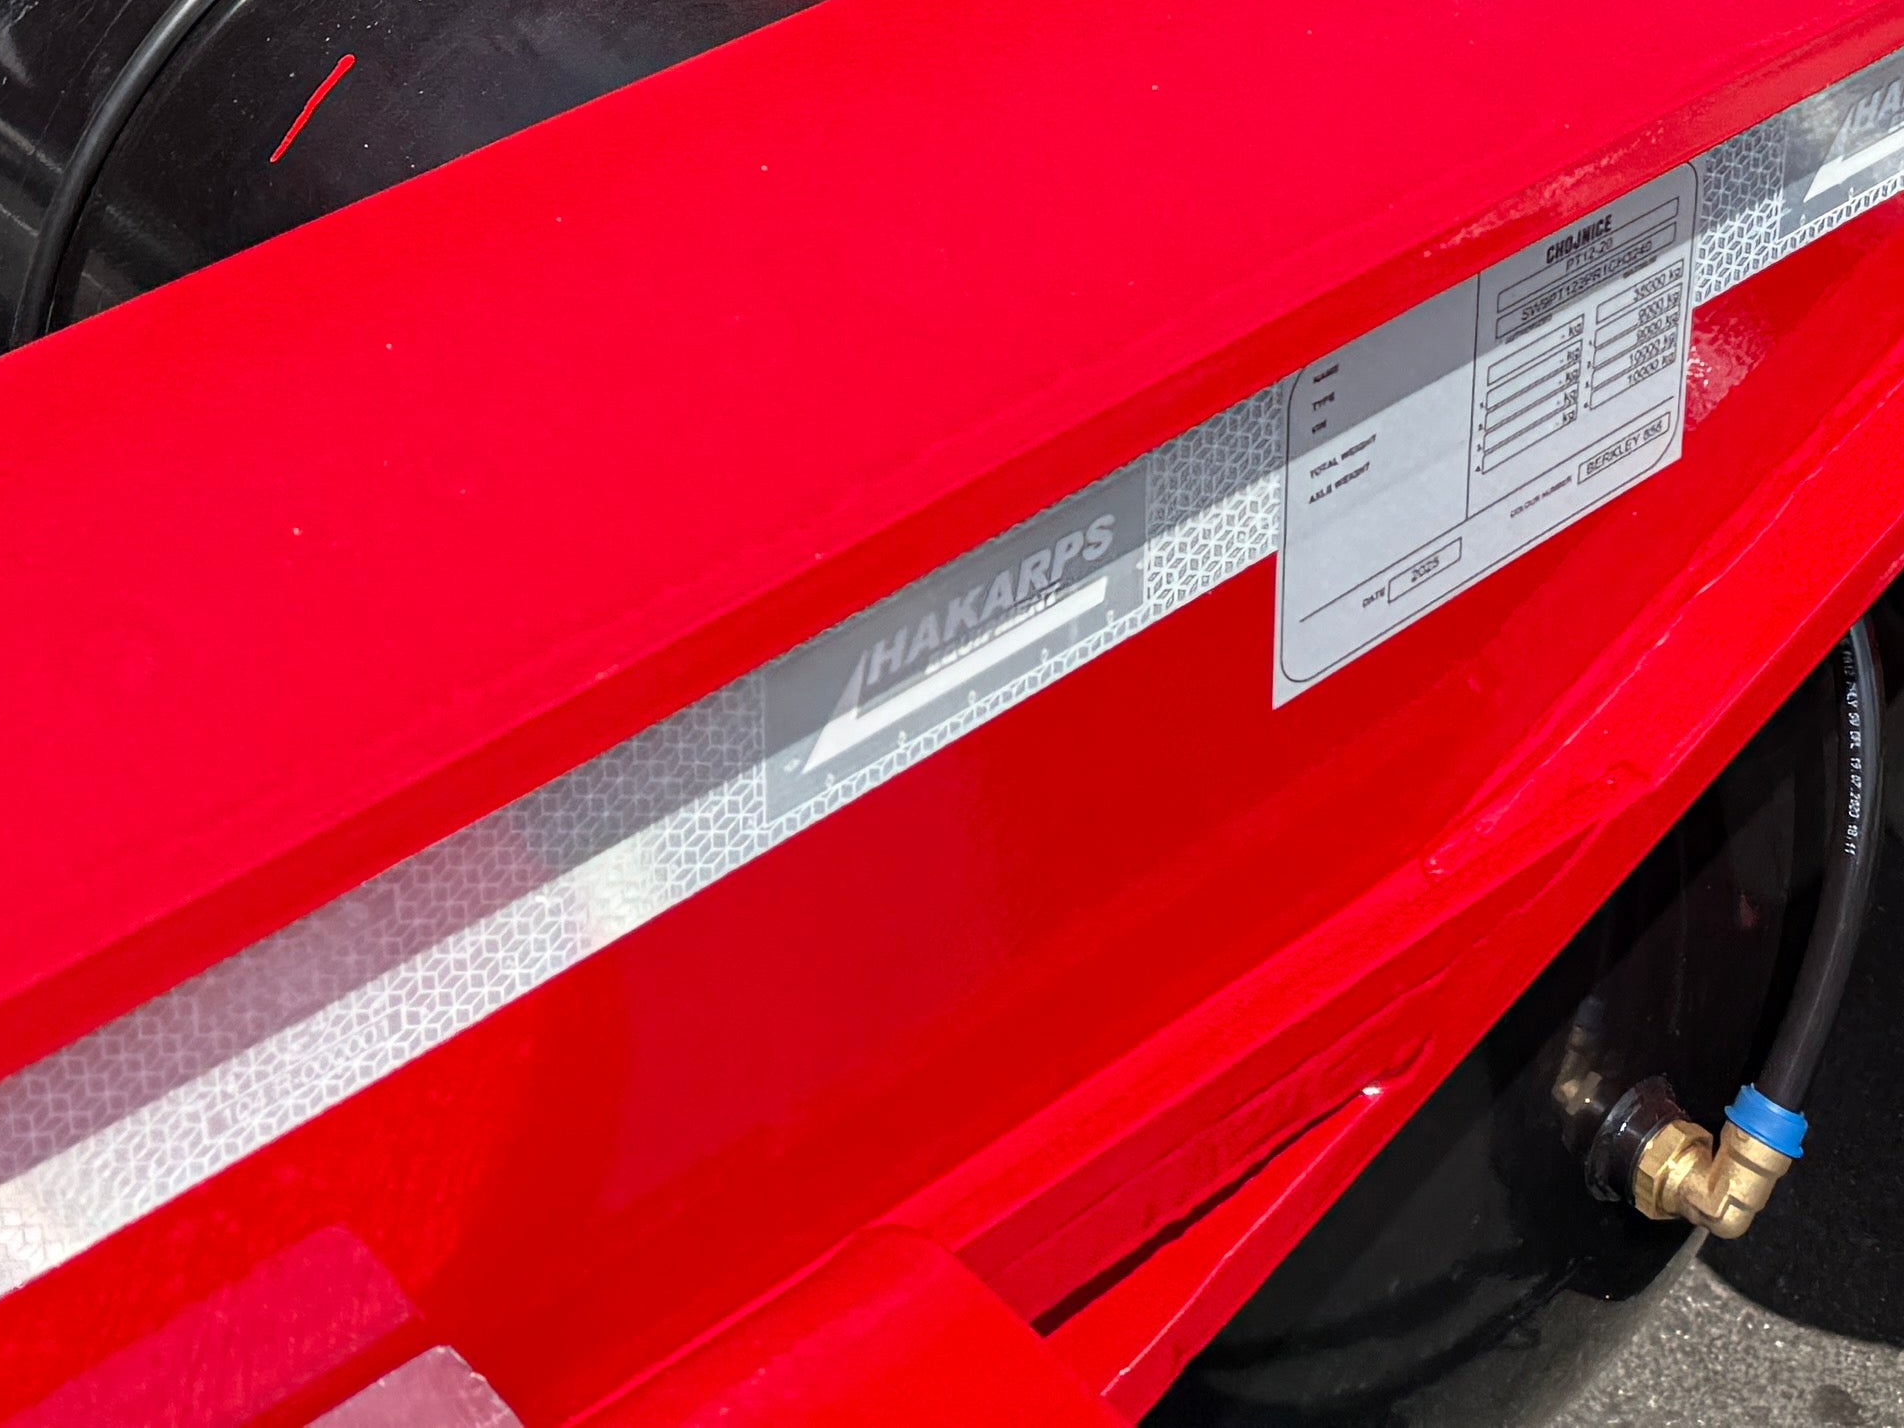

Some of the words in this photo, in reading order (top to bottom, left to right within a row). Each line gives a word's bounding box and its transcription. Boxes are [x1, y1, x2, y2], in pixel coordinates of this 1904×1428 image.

[1546, 214, 1613, 263] CHOJNICE
[1310, 457, 1338, 479] TOTAL
[1587, 433, 1640, 475] BERKLEY
[866, 513, 1116, 686] HAKARPS
[1362, 587, 1386, 608] DATE
